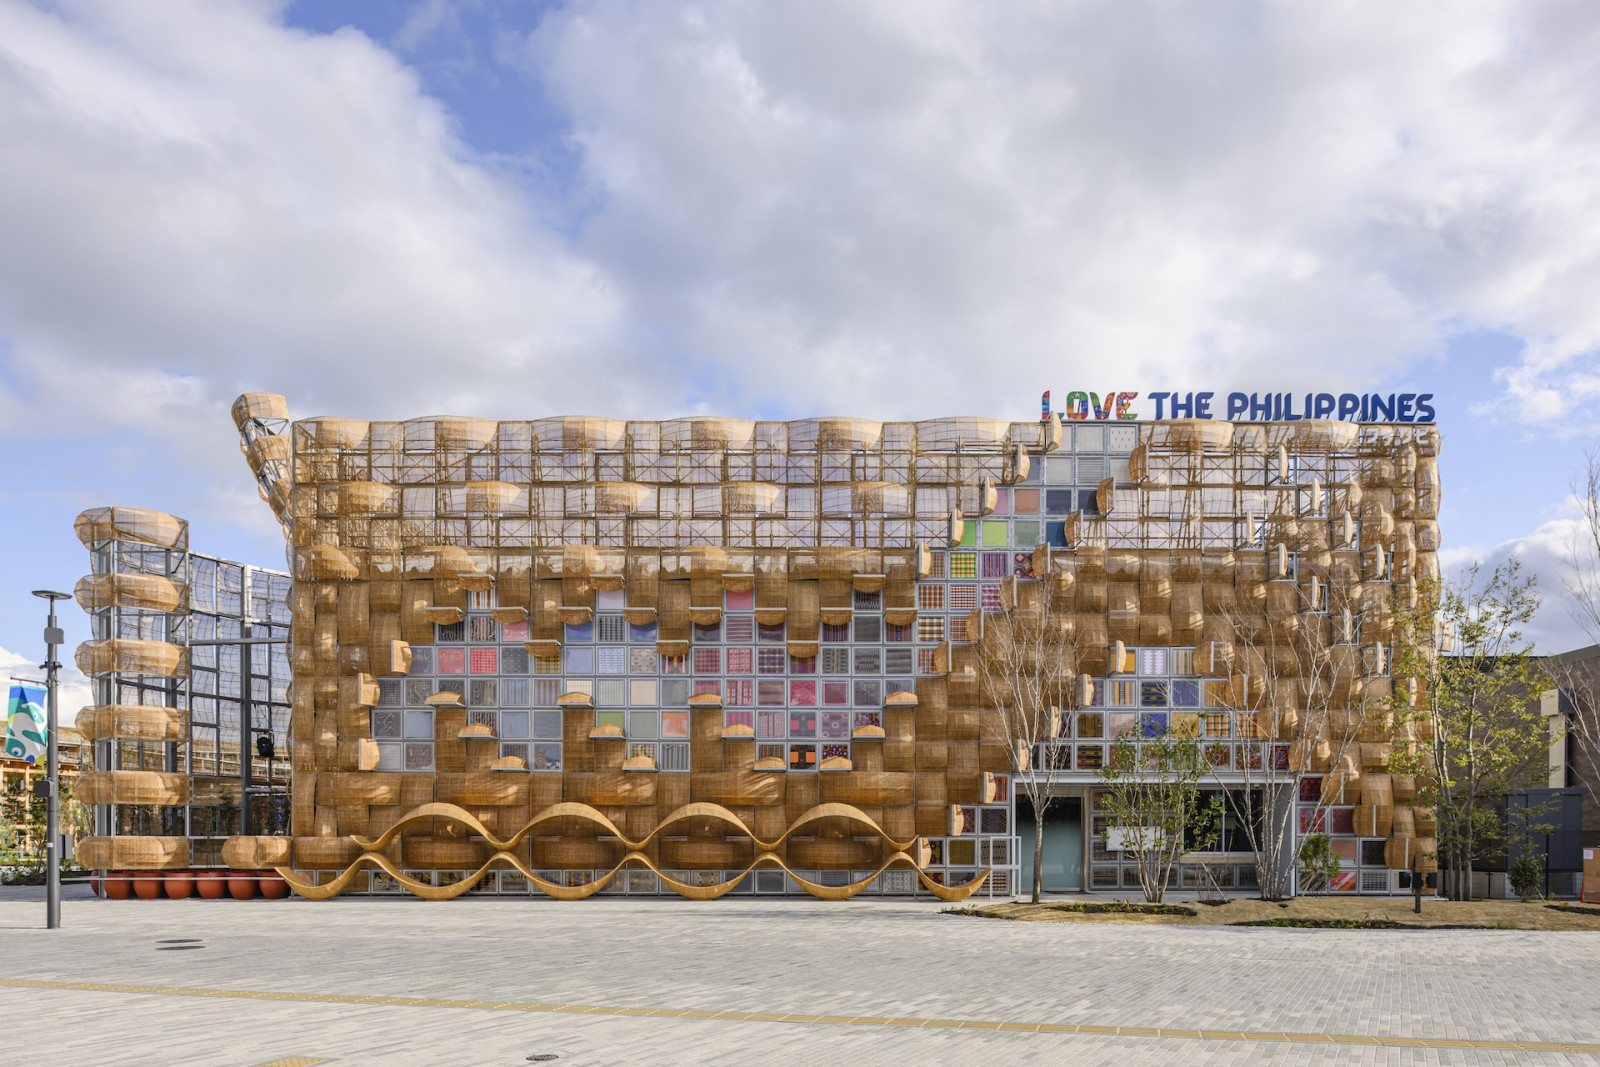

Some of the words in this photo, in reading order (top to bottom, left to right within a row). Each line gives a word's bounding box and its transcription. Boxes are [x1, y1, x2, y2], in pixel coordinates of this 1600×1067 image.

[1042, 391, 1138, 420] LOVE
[1148, 392, 1214, 420] THE
[1227, 392, 1436, 421] PHILIPPINES
